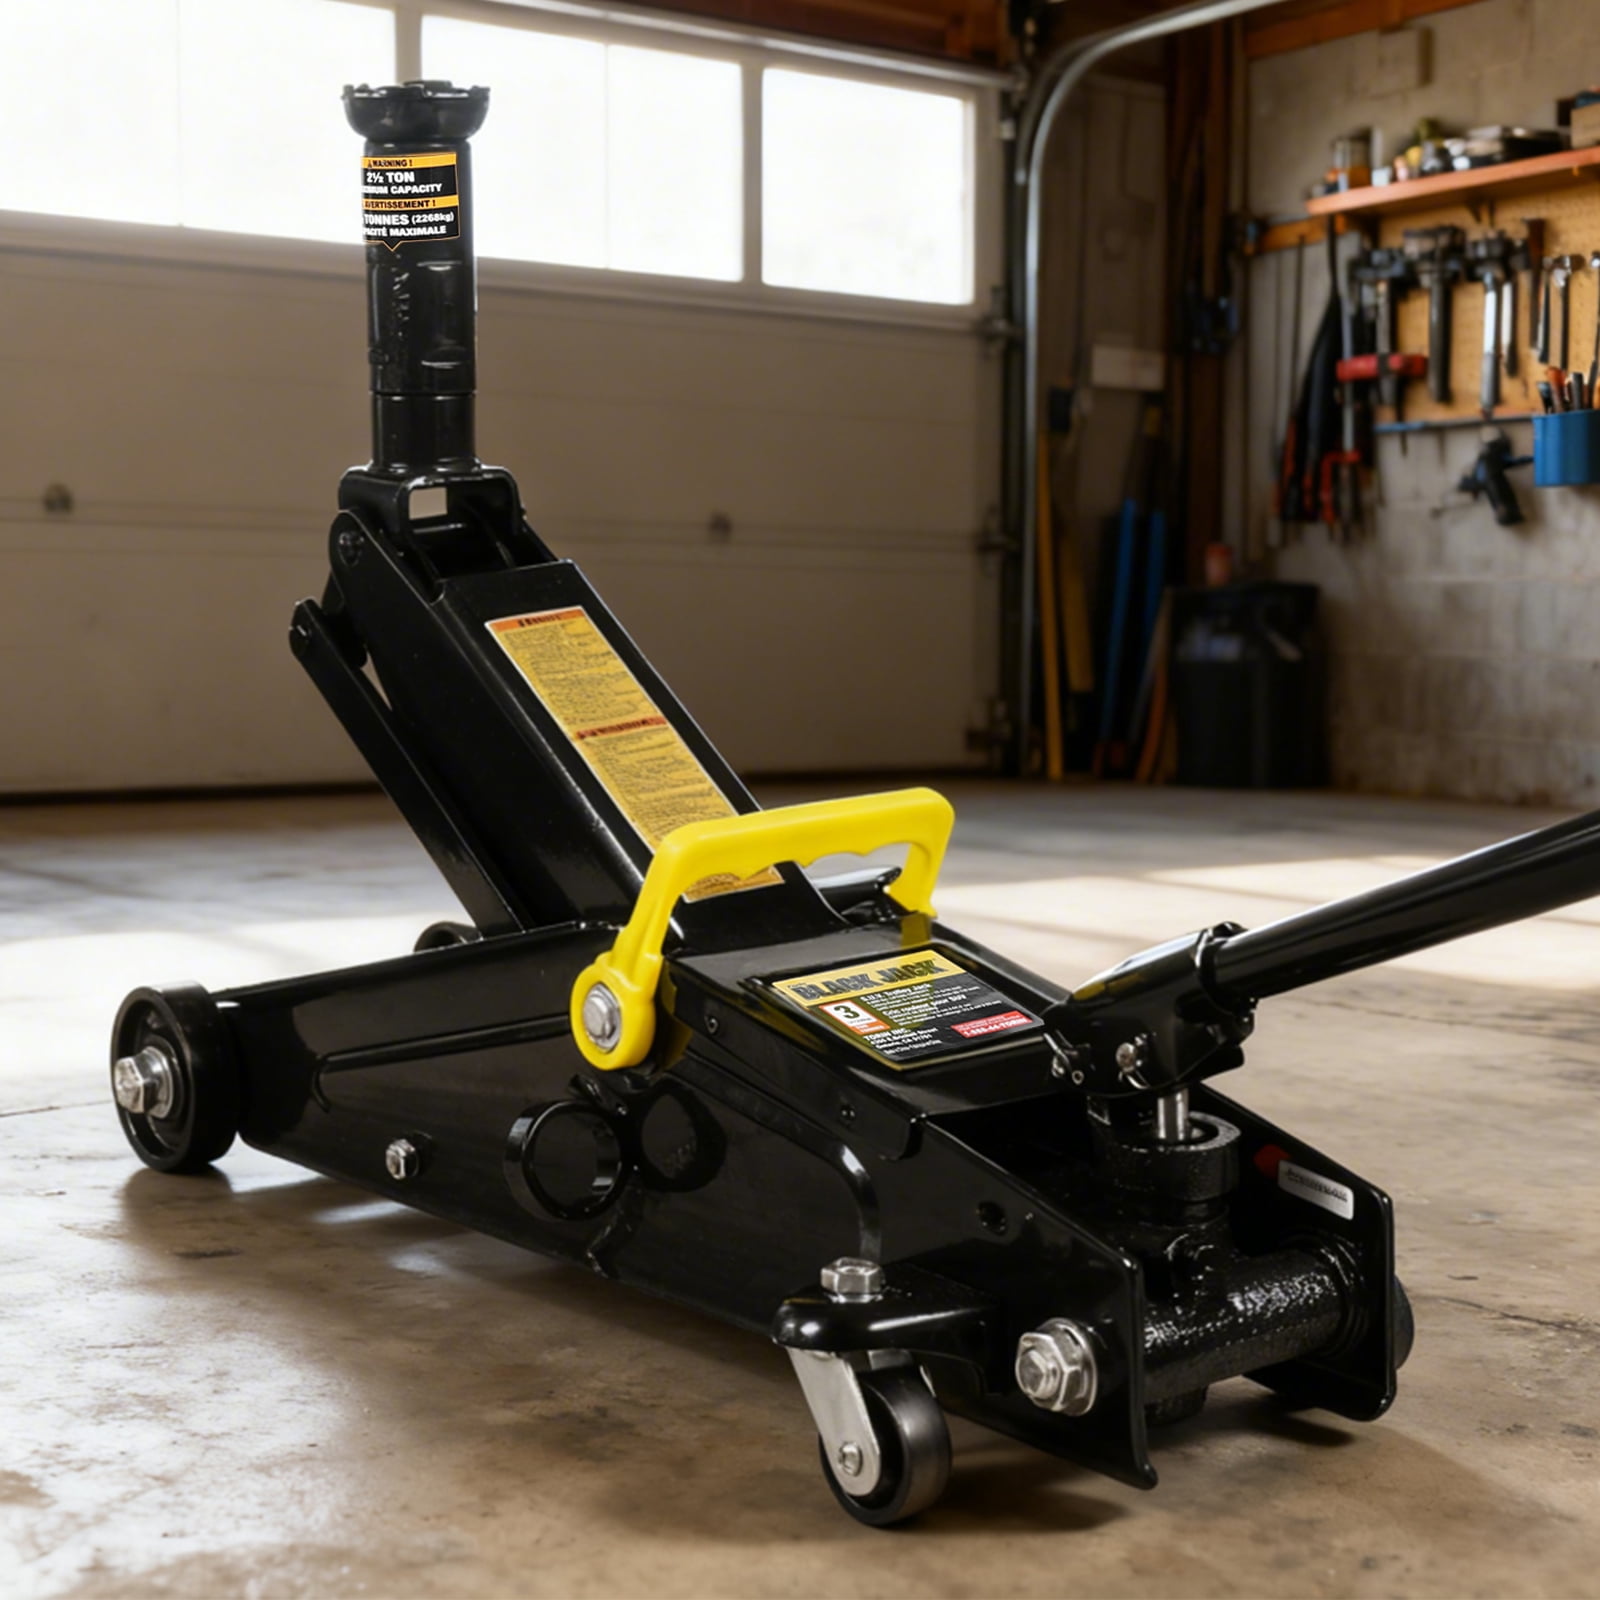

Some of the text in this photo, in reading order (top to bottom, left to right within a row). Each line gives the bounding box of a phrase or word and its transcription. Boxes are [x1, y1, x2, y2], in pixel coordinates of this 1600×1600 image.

[385, 171, 415, 183] TON
[390, 183, 442, 194] CAPACITY
[363, 211, 454, 225] TONNES (2268kg)
[389, 225, 447, 237] MAXIMALE
[791, 973, 884, 1000] BLACK
[876, 958, 949, 983] JACK
[834, 1005, 860, 1019] 3
